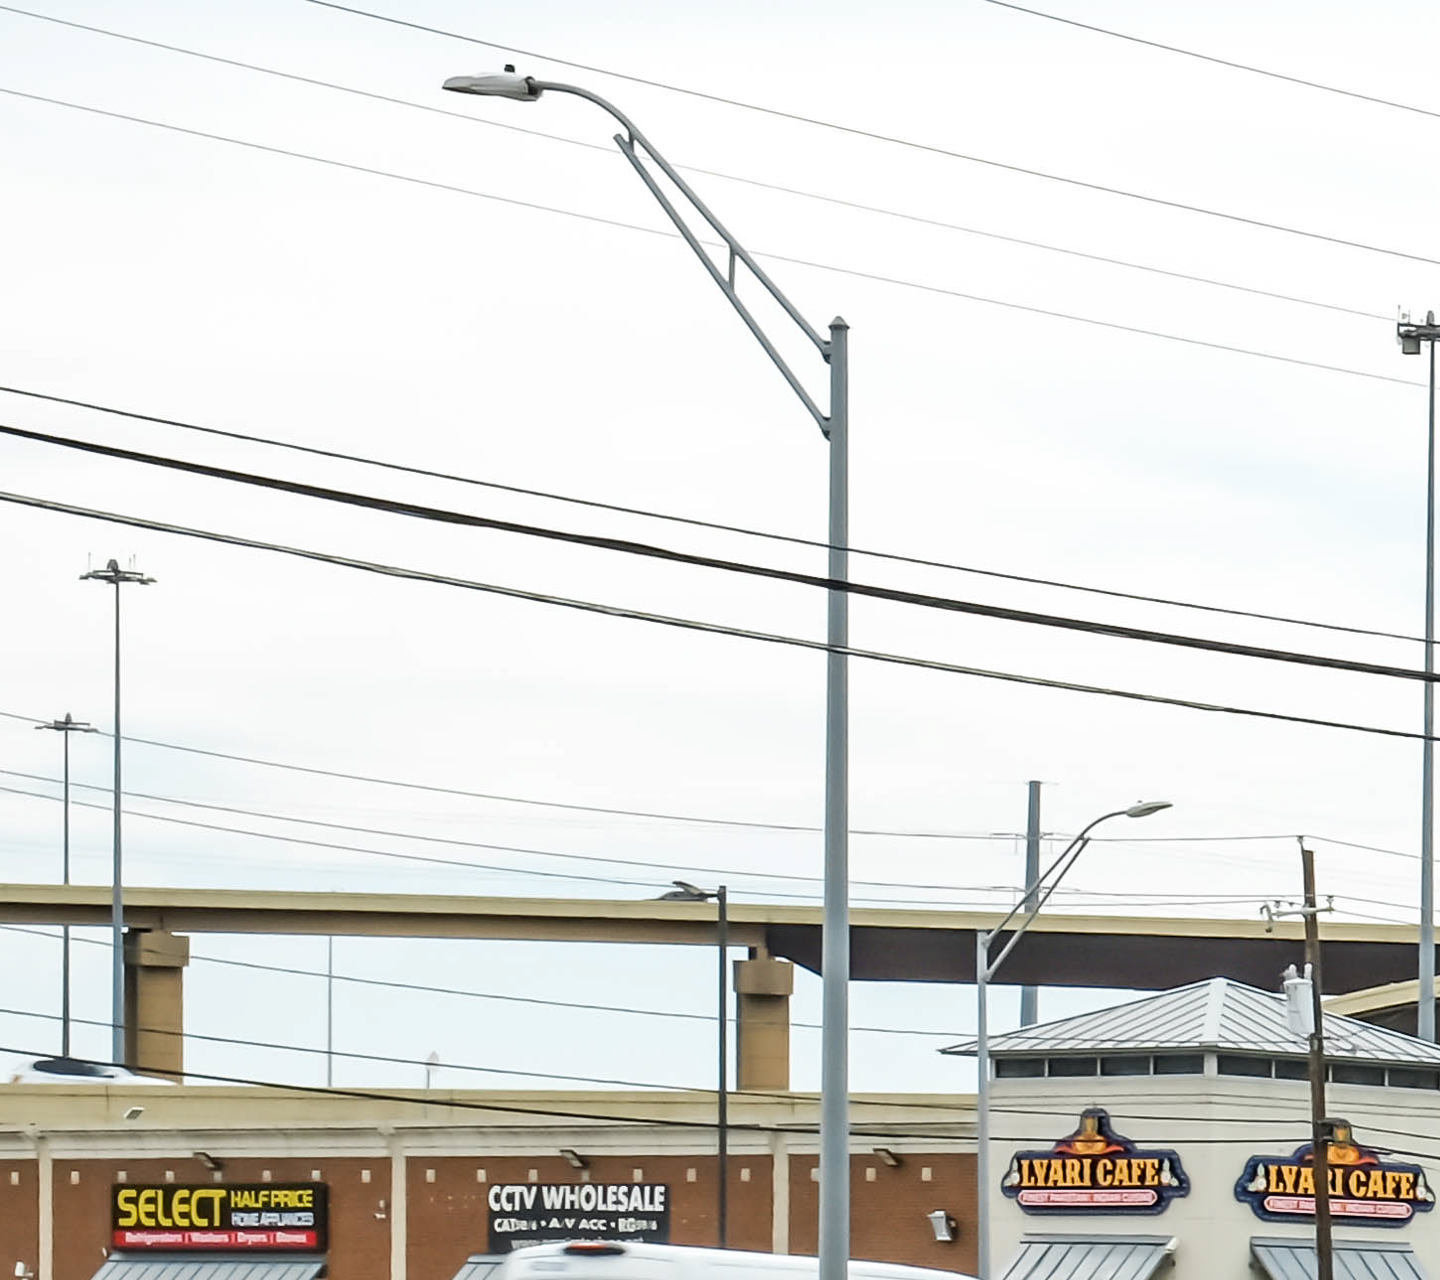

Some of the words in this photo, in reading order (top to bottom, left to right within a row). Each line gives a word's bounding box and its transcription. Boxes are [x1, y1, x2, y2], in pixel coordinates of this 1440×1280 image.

[1020, 1158, 1092, 1187] LYARI
[1096, 1158, 1159, 1187] CAFE
[1349, 1169, 1415, 1199] CAFE
[117, 1189, 227, 1227] SELECT
[230, 1190, 270, 1208] HALF
[271, 1190, 313, 1208] PRICE
[488, 1185, 537, 1212] CCTV
[542, 1185, 665, 1212] WHOLESALE
[578, 1218, 607, 1231] ACC
